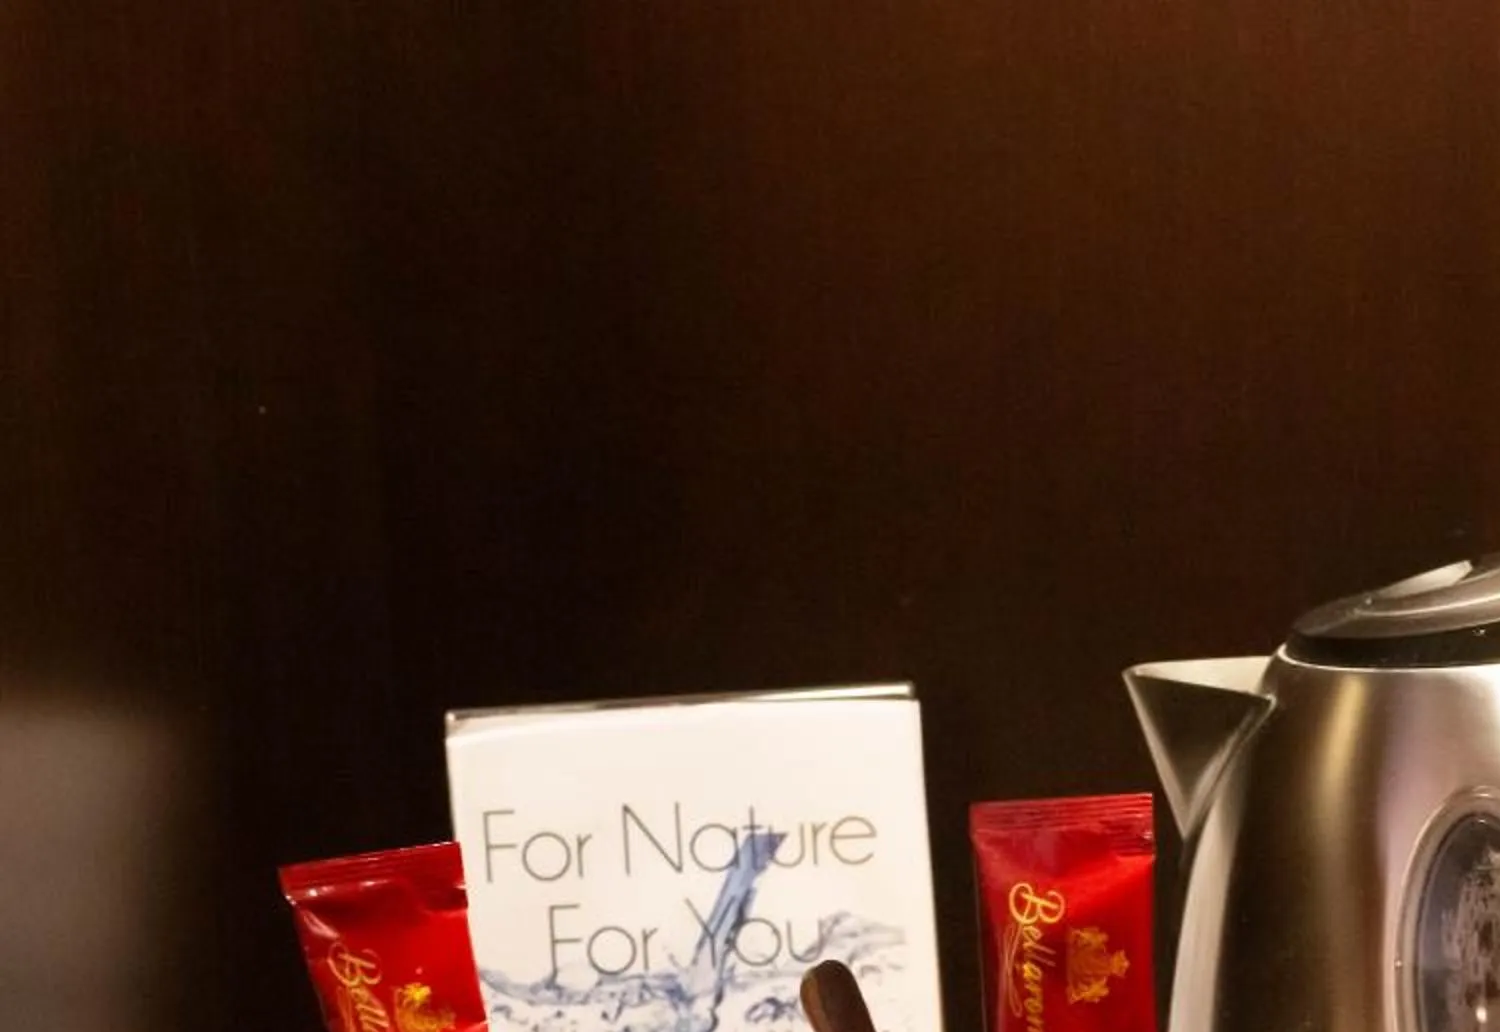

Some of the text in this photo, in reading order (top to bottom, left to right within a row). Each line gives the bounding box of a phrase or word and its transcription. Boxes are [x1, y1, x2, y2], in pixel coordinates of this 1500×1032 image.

[483, 802, 878, 883] For Nature
[548, 896, 828, 978] For You
